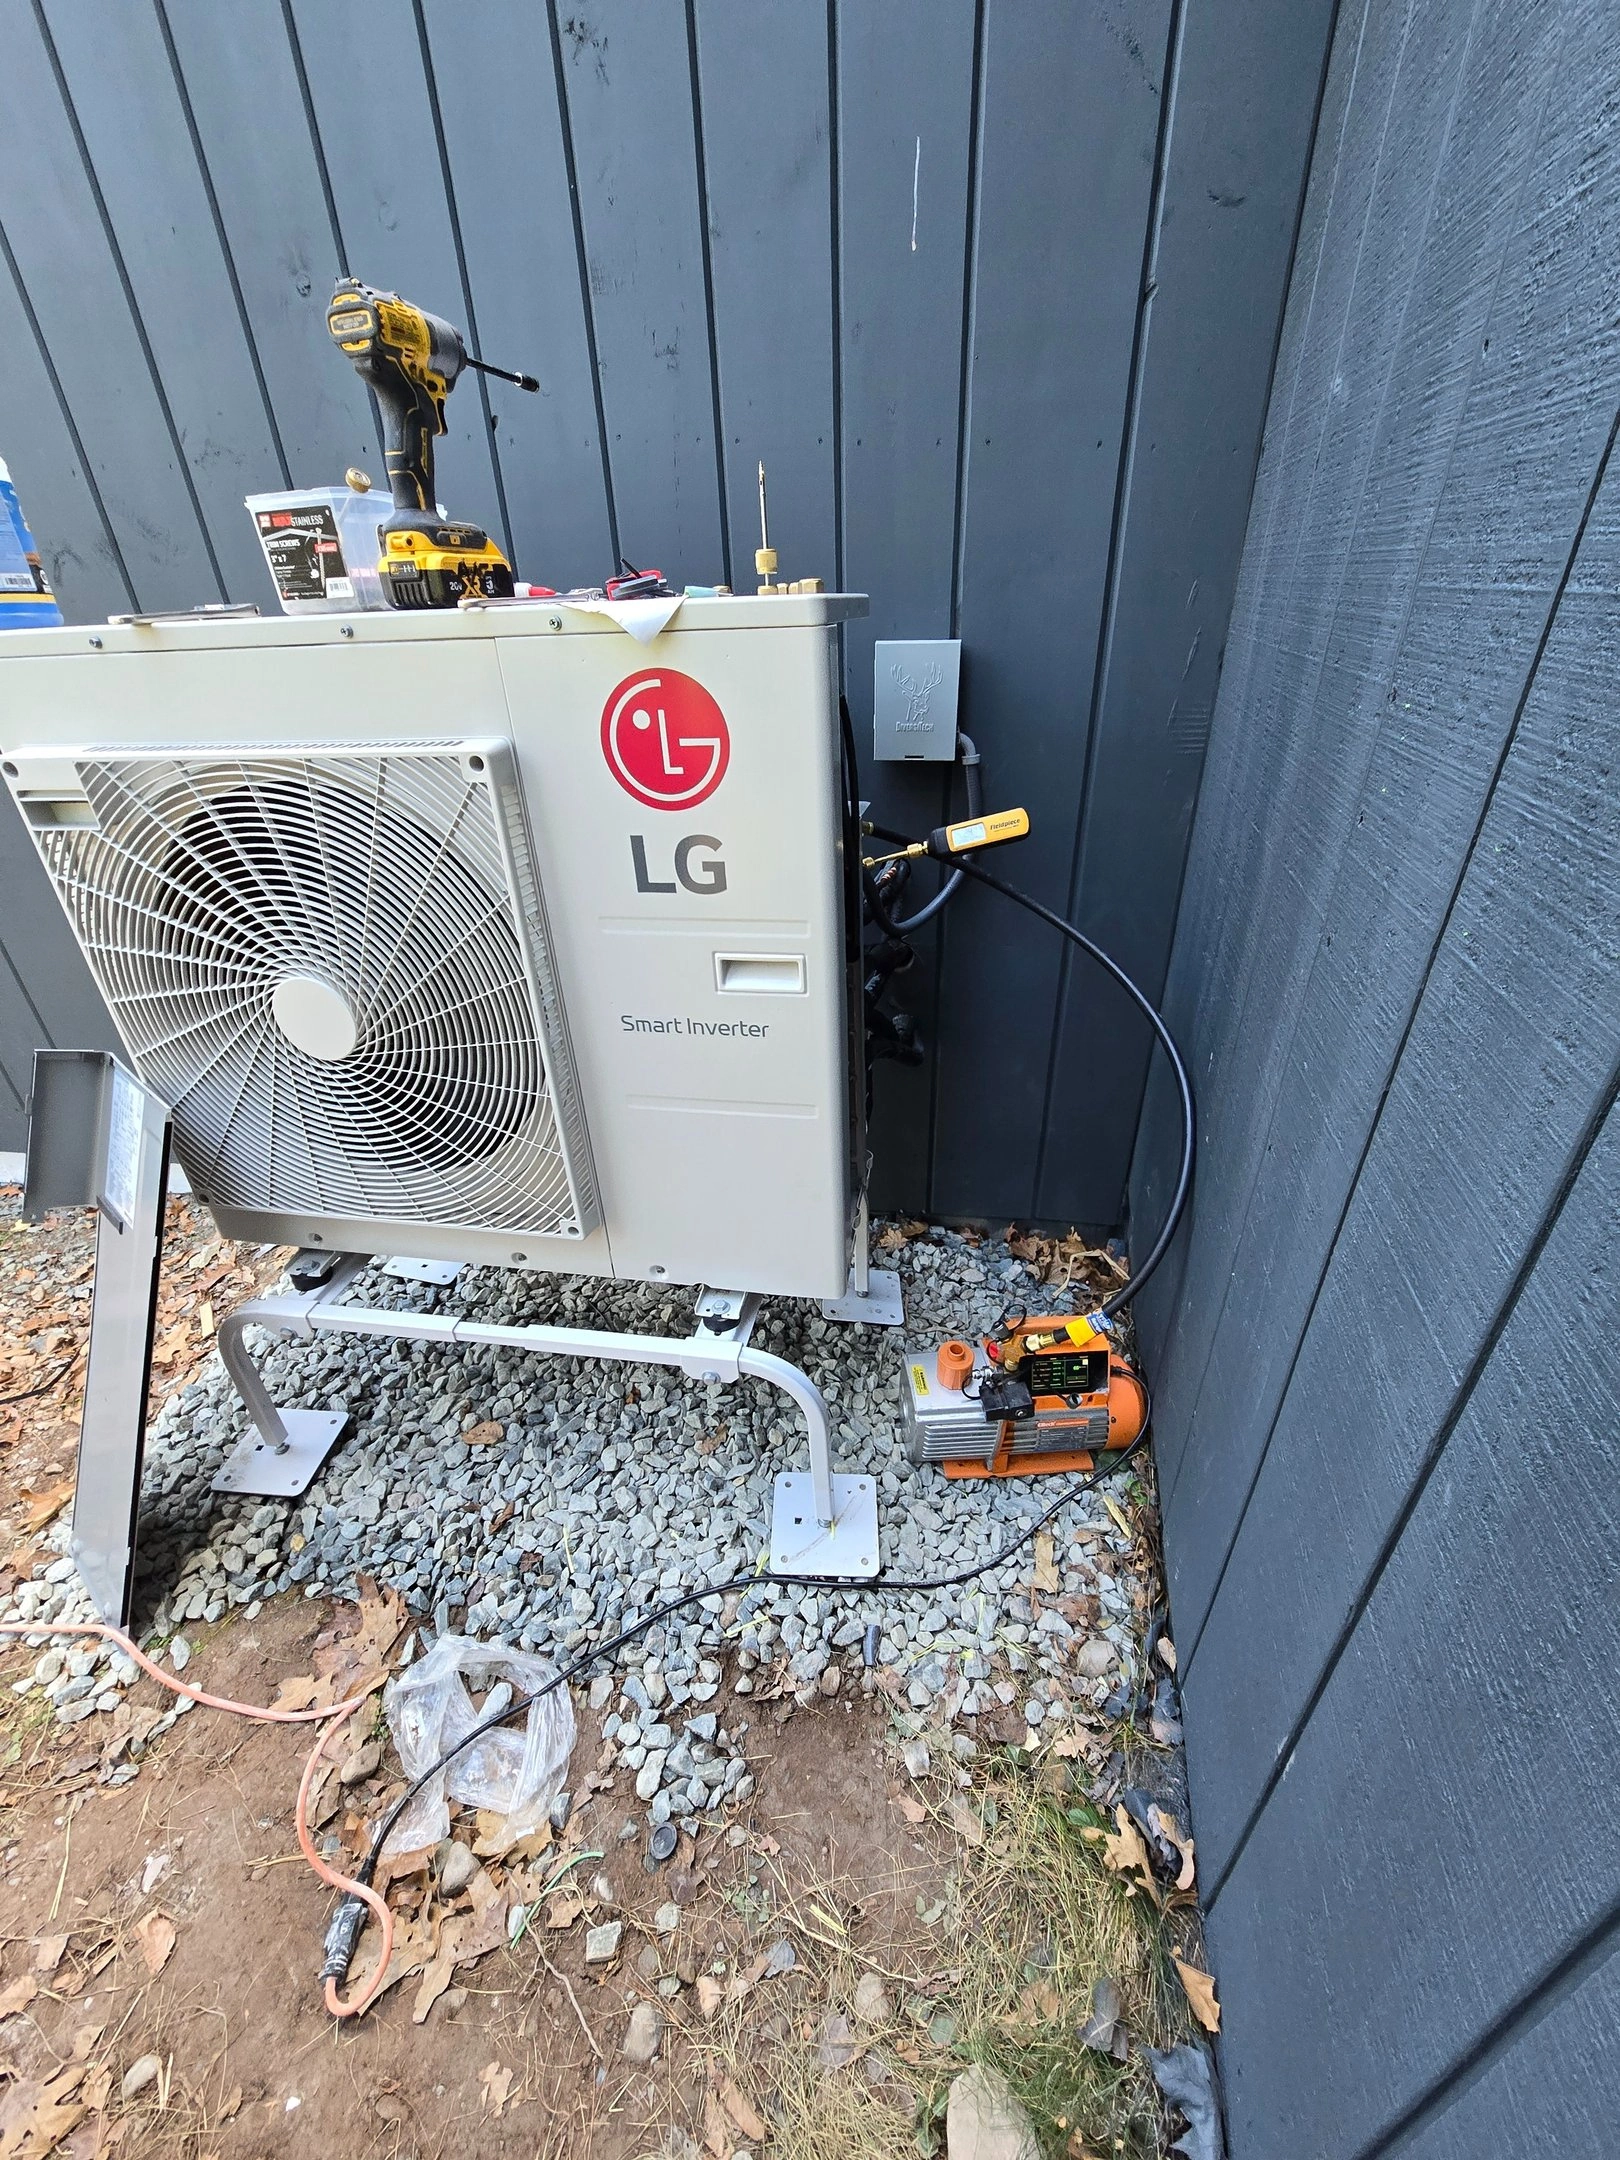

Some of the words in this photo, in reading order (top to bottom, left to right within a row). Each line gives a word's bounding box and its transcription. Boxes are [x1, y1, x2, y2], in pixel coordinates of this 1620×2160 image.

[290, 514, 324, 527] STAINLESS
[990, 818, 1021, 831] Fieldpiece
[629, 834, 728, 895] LG
[620, 1015, 683, 1034] Smart
[686, 1017, 769, 1038] Inverter
